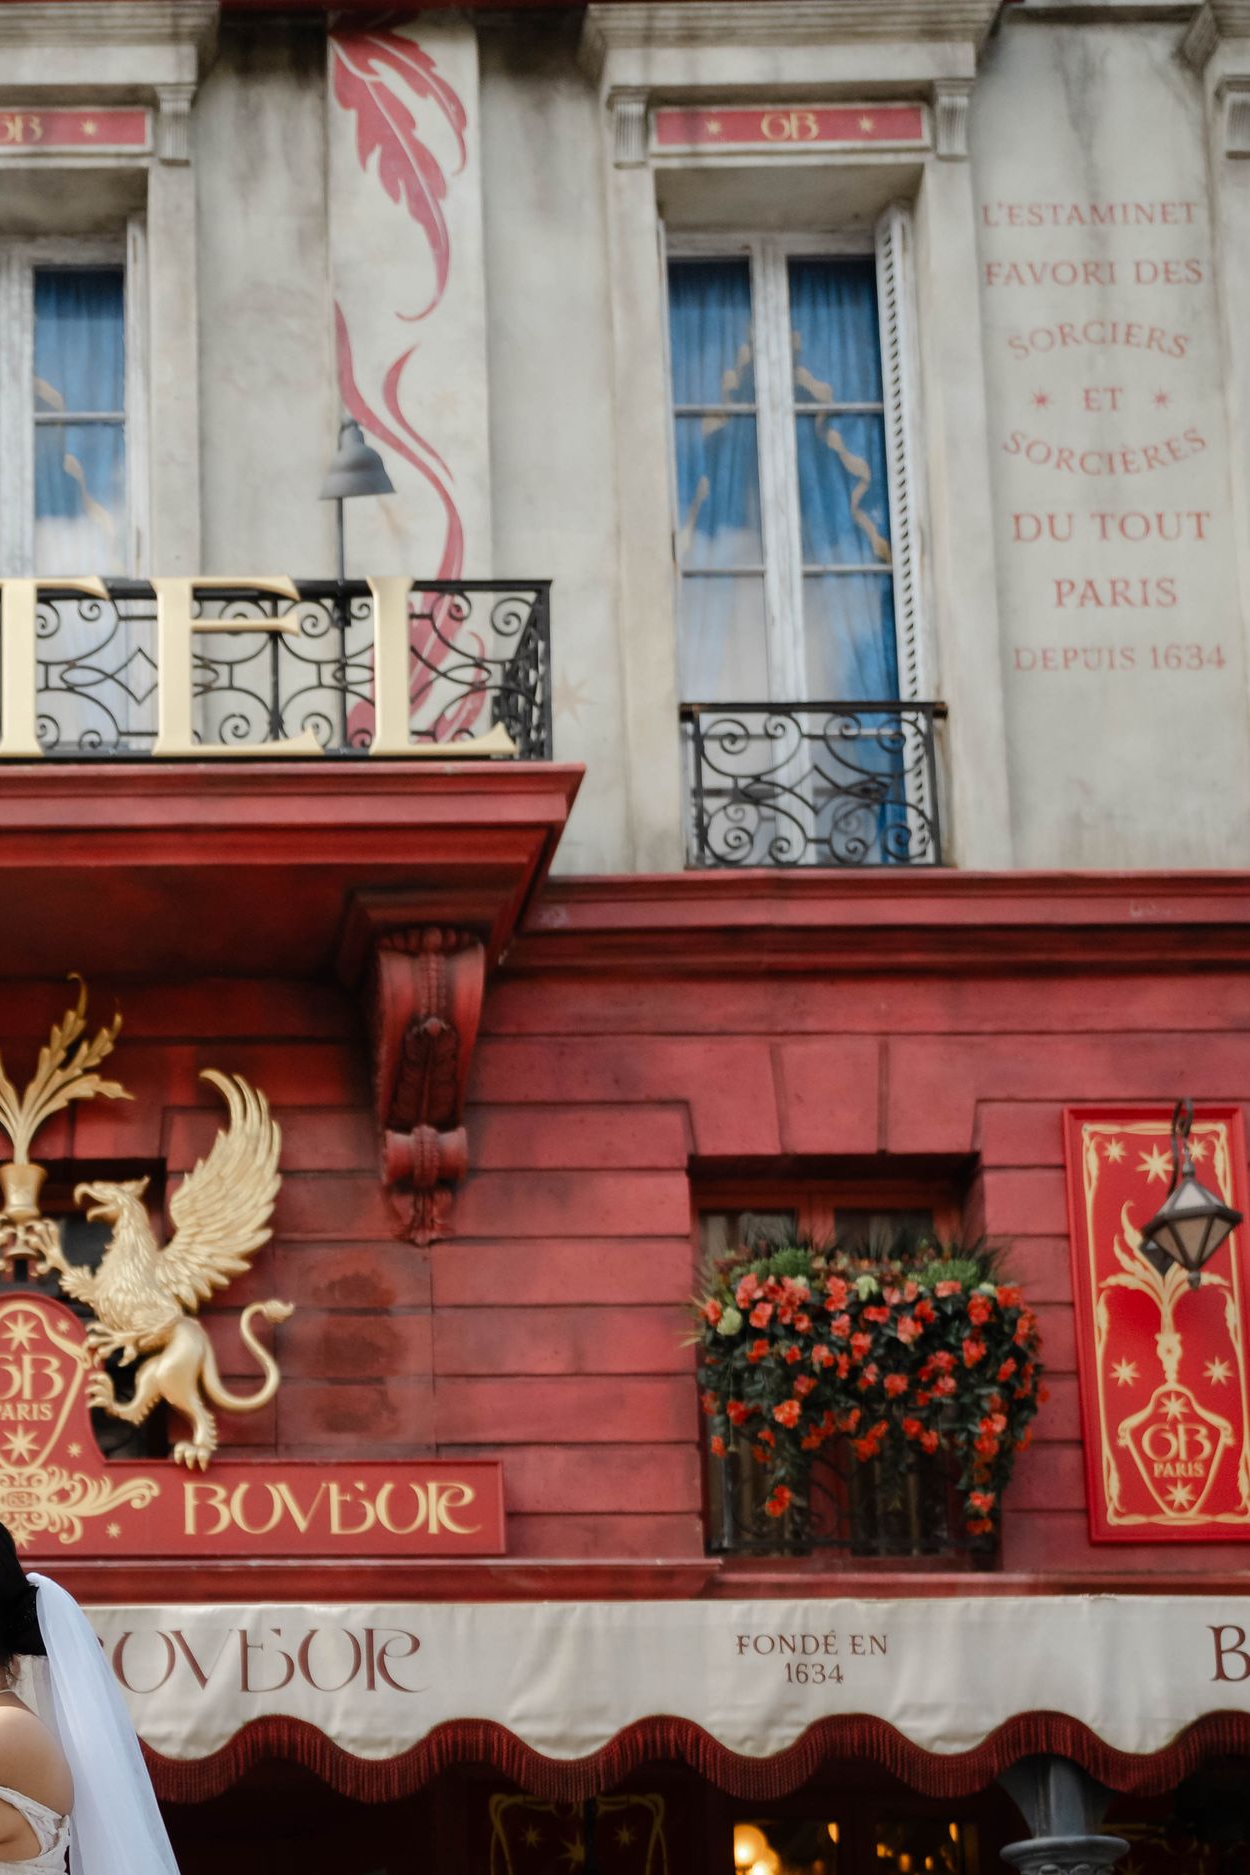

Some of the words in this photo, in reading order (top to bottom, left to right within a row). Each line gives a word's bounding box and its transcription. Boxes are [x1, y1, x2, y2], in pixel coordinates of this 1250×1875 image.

[982, 202, 1196, 227] L'ESTAMINET
[984, 260, 1116, 287] FAVORI
[1135, 259, 1203, 284] DES
[1008, 320, 1189, 359] SORCIERS
[1083, 387, 1122, 411] ET
[1003, 428, 1207, 476] SORCIÈRES
[1011, 512, 1074, 543] DU
[1090, 511, 1211, 541] TOUT
[1054, 577, 1177, 608] PARIS
[1014, 646, 1135, 671] DEPUIS
[1149, 644, 1226, 670] 1634
[1141, 1423, 1211, 1462] GB
[1153, 1462, 1203, 1479] PARIS
[736, 1629, 839, 1656] FONDÉ
[850, 1634, 889, 1656] EN
[784, 1662, 845, 1685] 1634
